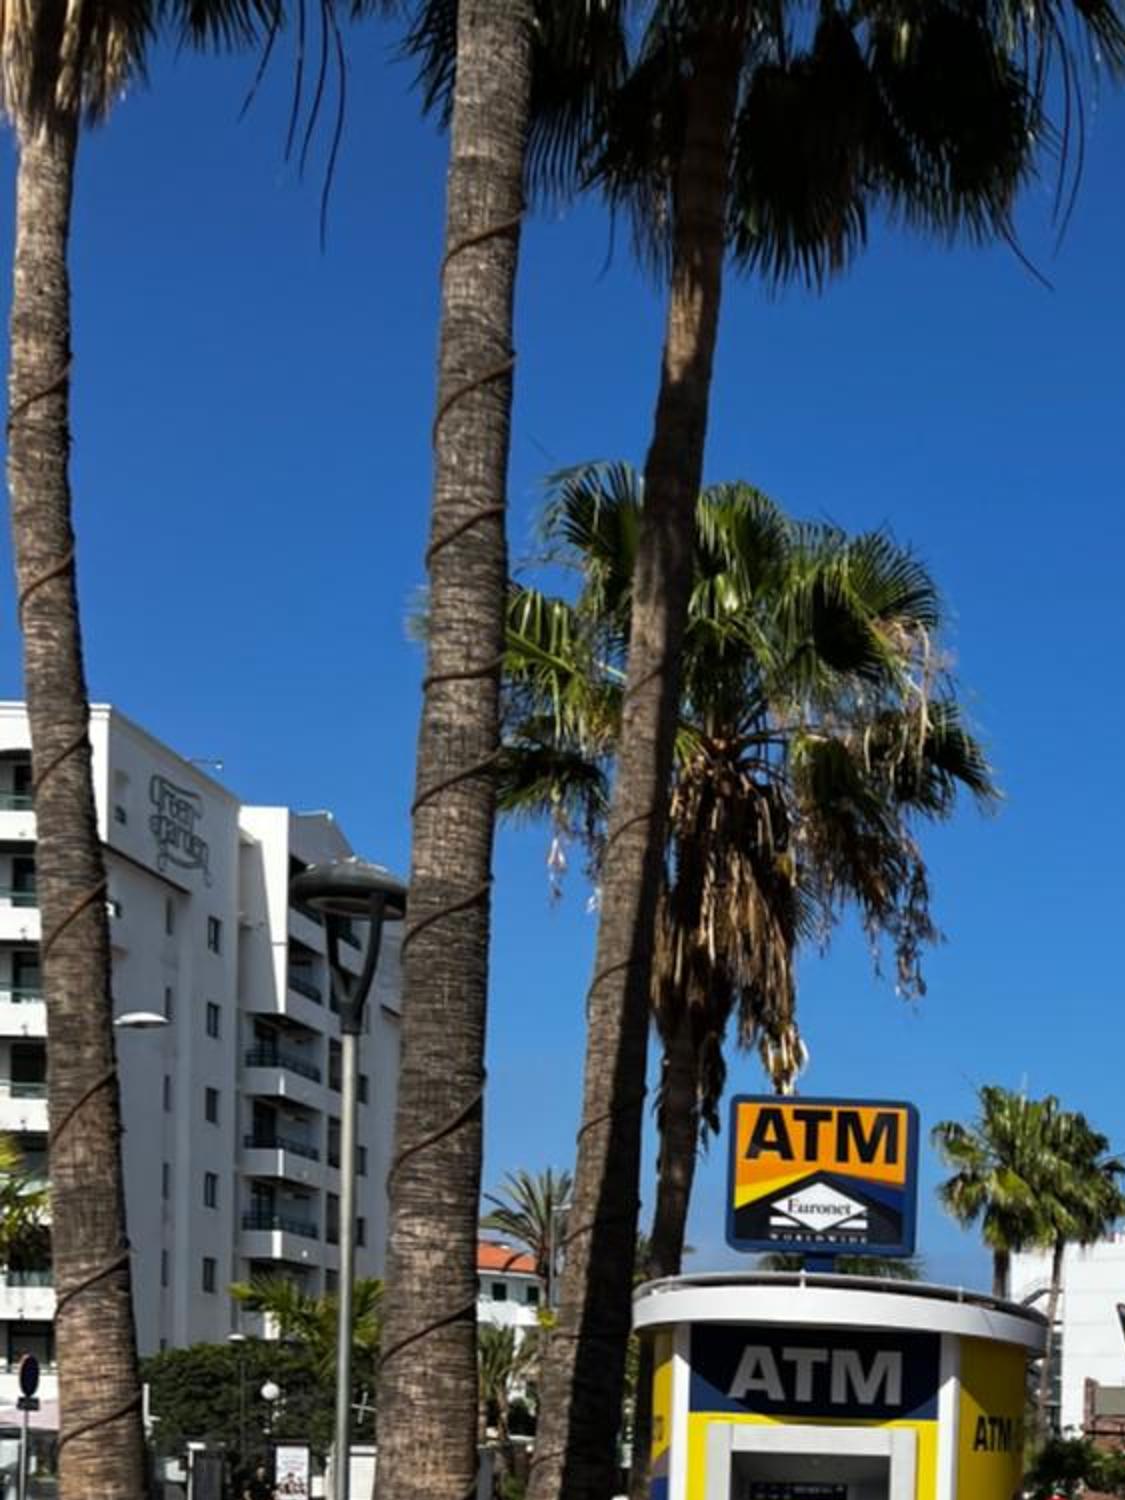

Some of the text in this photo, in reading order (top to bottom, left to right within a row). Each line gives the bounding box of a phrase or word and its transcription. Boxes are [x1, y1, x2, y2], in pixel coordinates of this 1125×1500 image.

[745, 1106, 899, 1164] ATM
[788, 1199, 852, 1216] Euronet
[769, 1230, 868, 1244] WORLDWIDE
[727, 1344, 903, 1406] ATM
